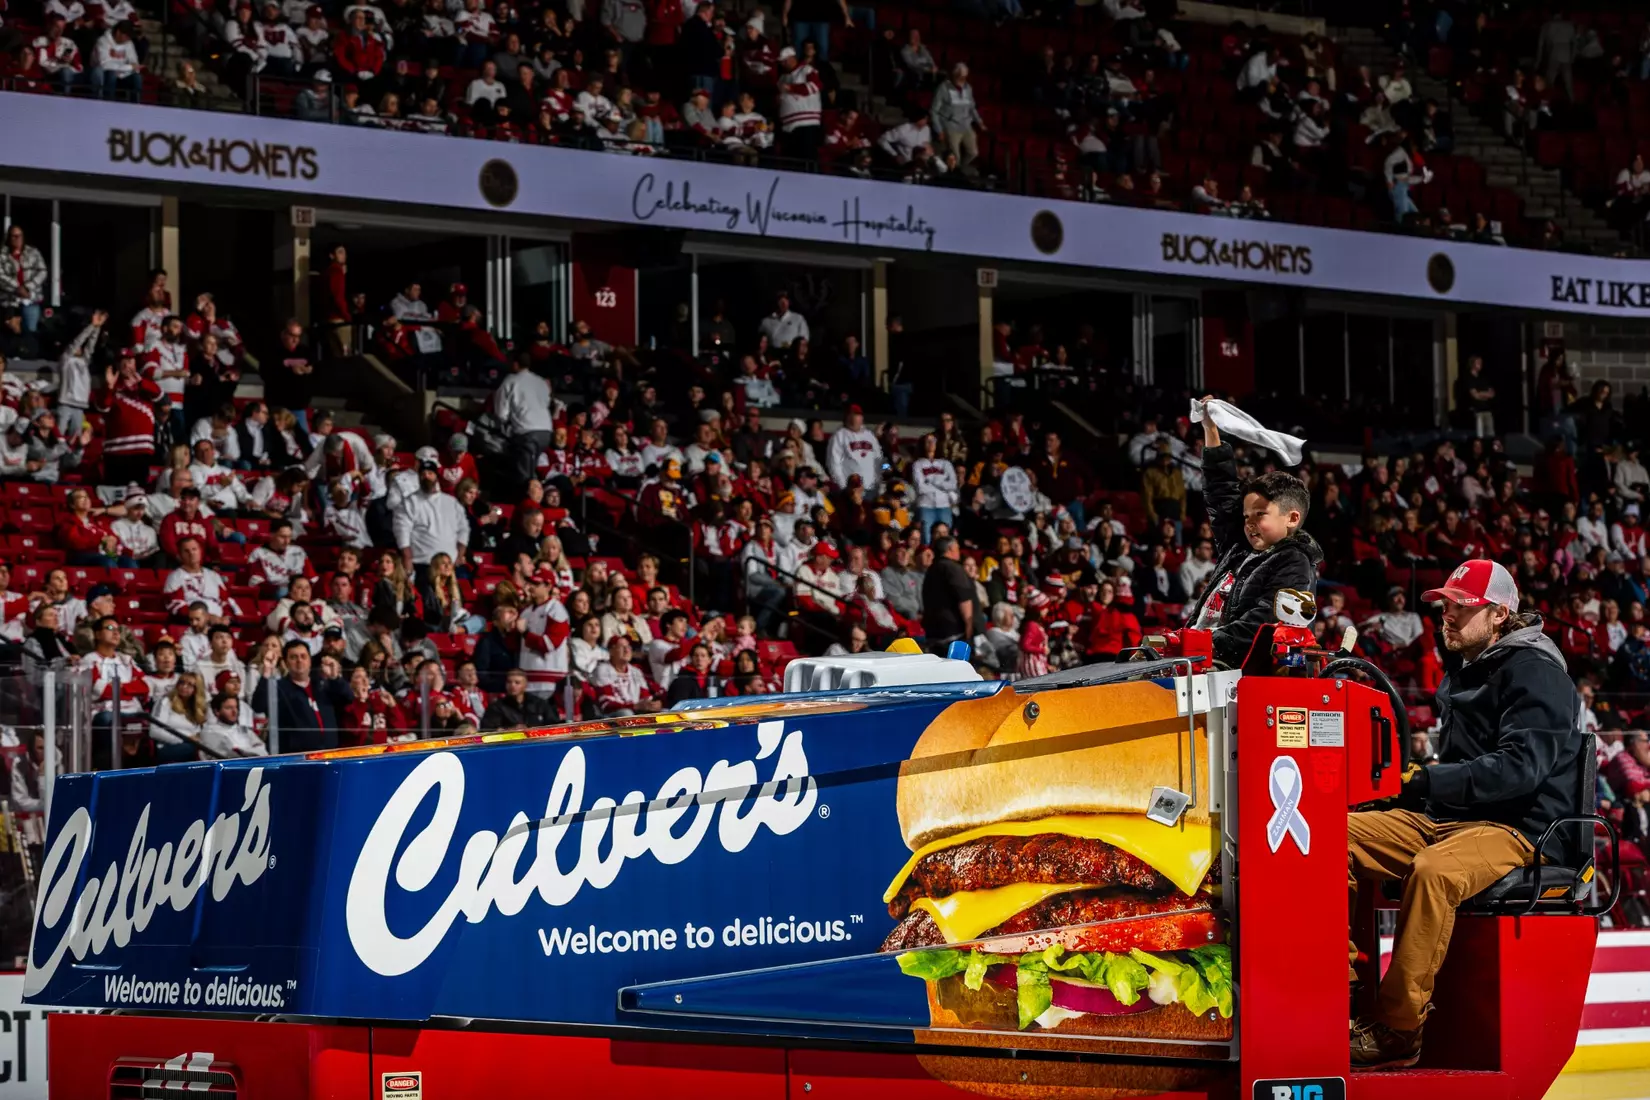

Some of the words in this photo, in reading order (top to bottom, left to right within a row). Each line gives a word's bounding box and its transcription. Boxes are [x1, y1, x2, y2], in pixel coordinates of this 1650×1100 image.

[633, 172, 741, 229] Celebrating
[746, 176, 828, 236] Wisconsin
[832, 196, 936, 251] Hospitality
[594, 291, 617, 307] 123
[1550, 274, 1592, 305] EAT
[1596, 280, 1650, 308] LIKE
[1282, 714, 1302, 722] DANGER
[1272, 799, 1295, 837] ZAMMAN
[538, 926, 677, 957] Welcome
[685, 922, 715, 948] to
[104, 975, 178, 1003] Welcome
[184, 978, 202, 1004] to
